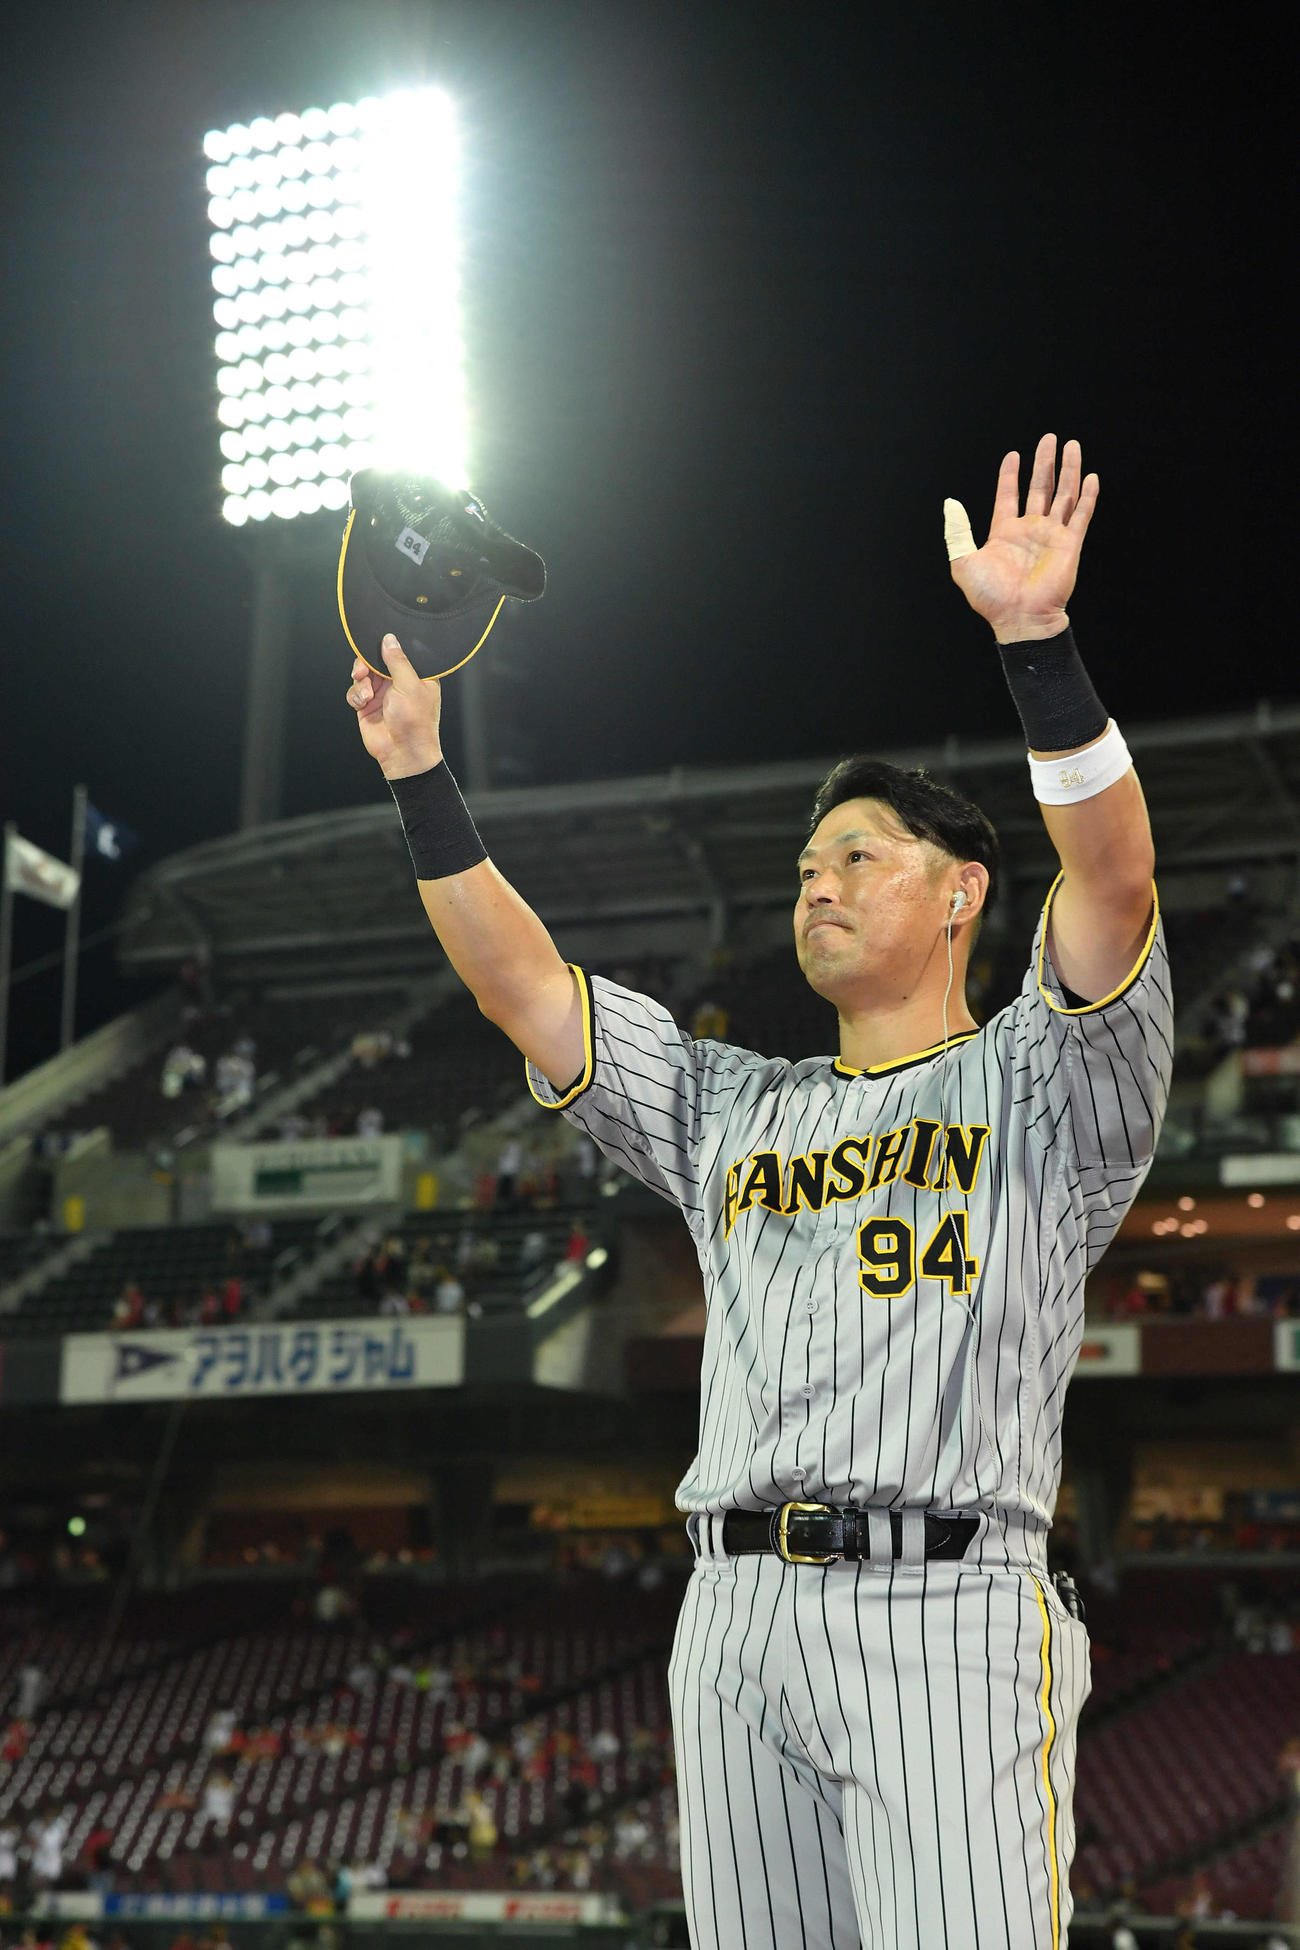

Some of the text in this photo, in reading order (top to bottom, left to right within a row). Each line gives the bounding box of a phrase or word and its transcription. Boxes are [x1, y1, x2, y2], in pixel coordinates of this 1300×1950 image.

[404, 536, 421, 555] 94
[724, 1117, 992, 1242] HANSHIN
[857, 1210, 980, 1299] 94
